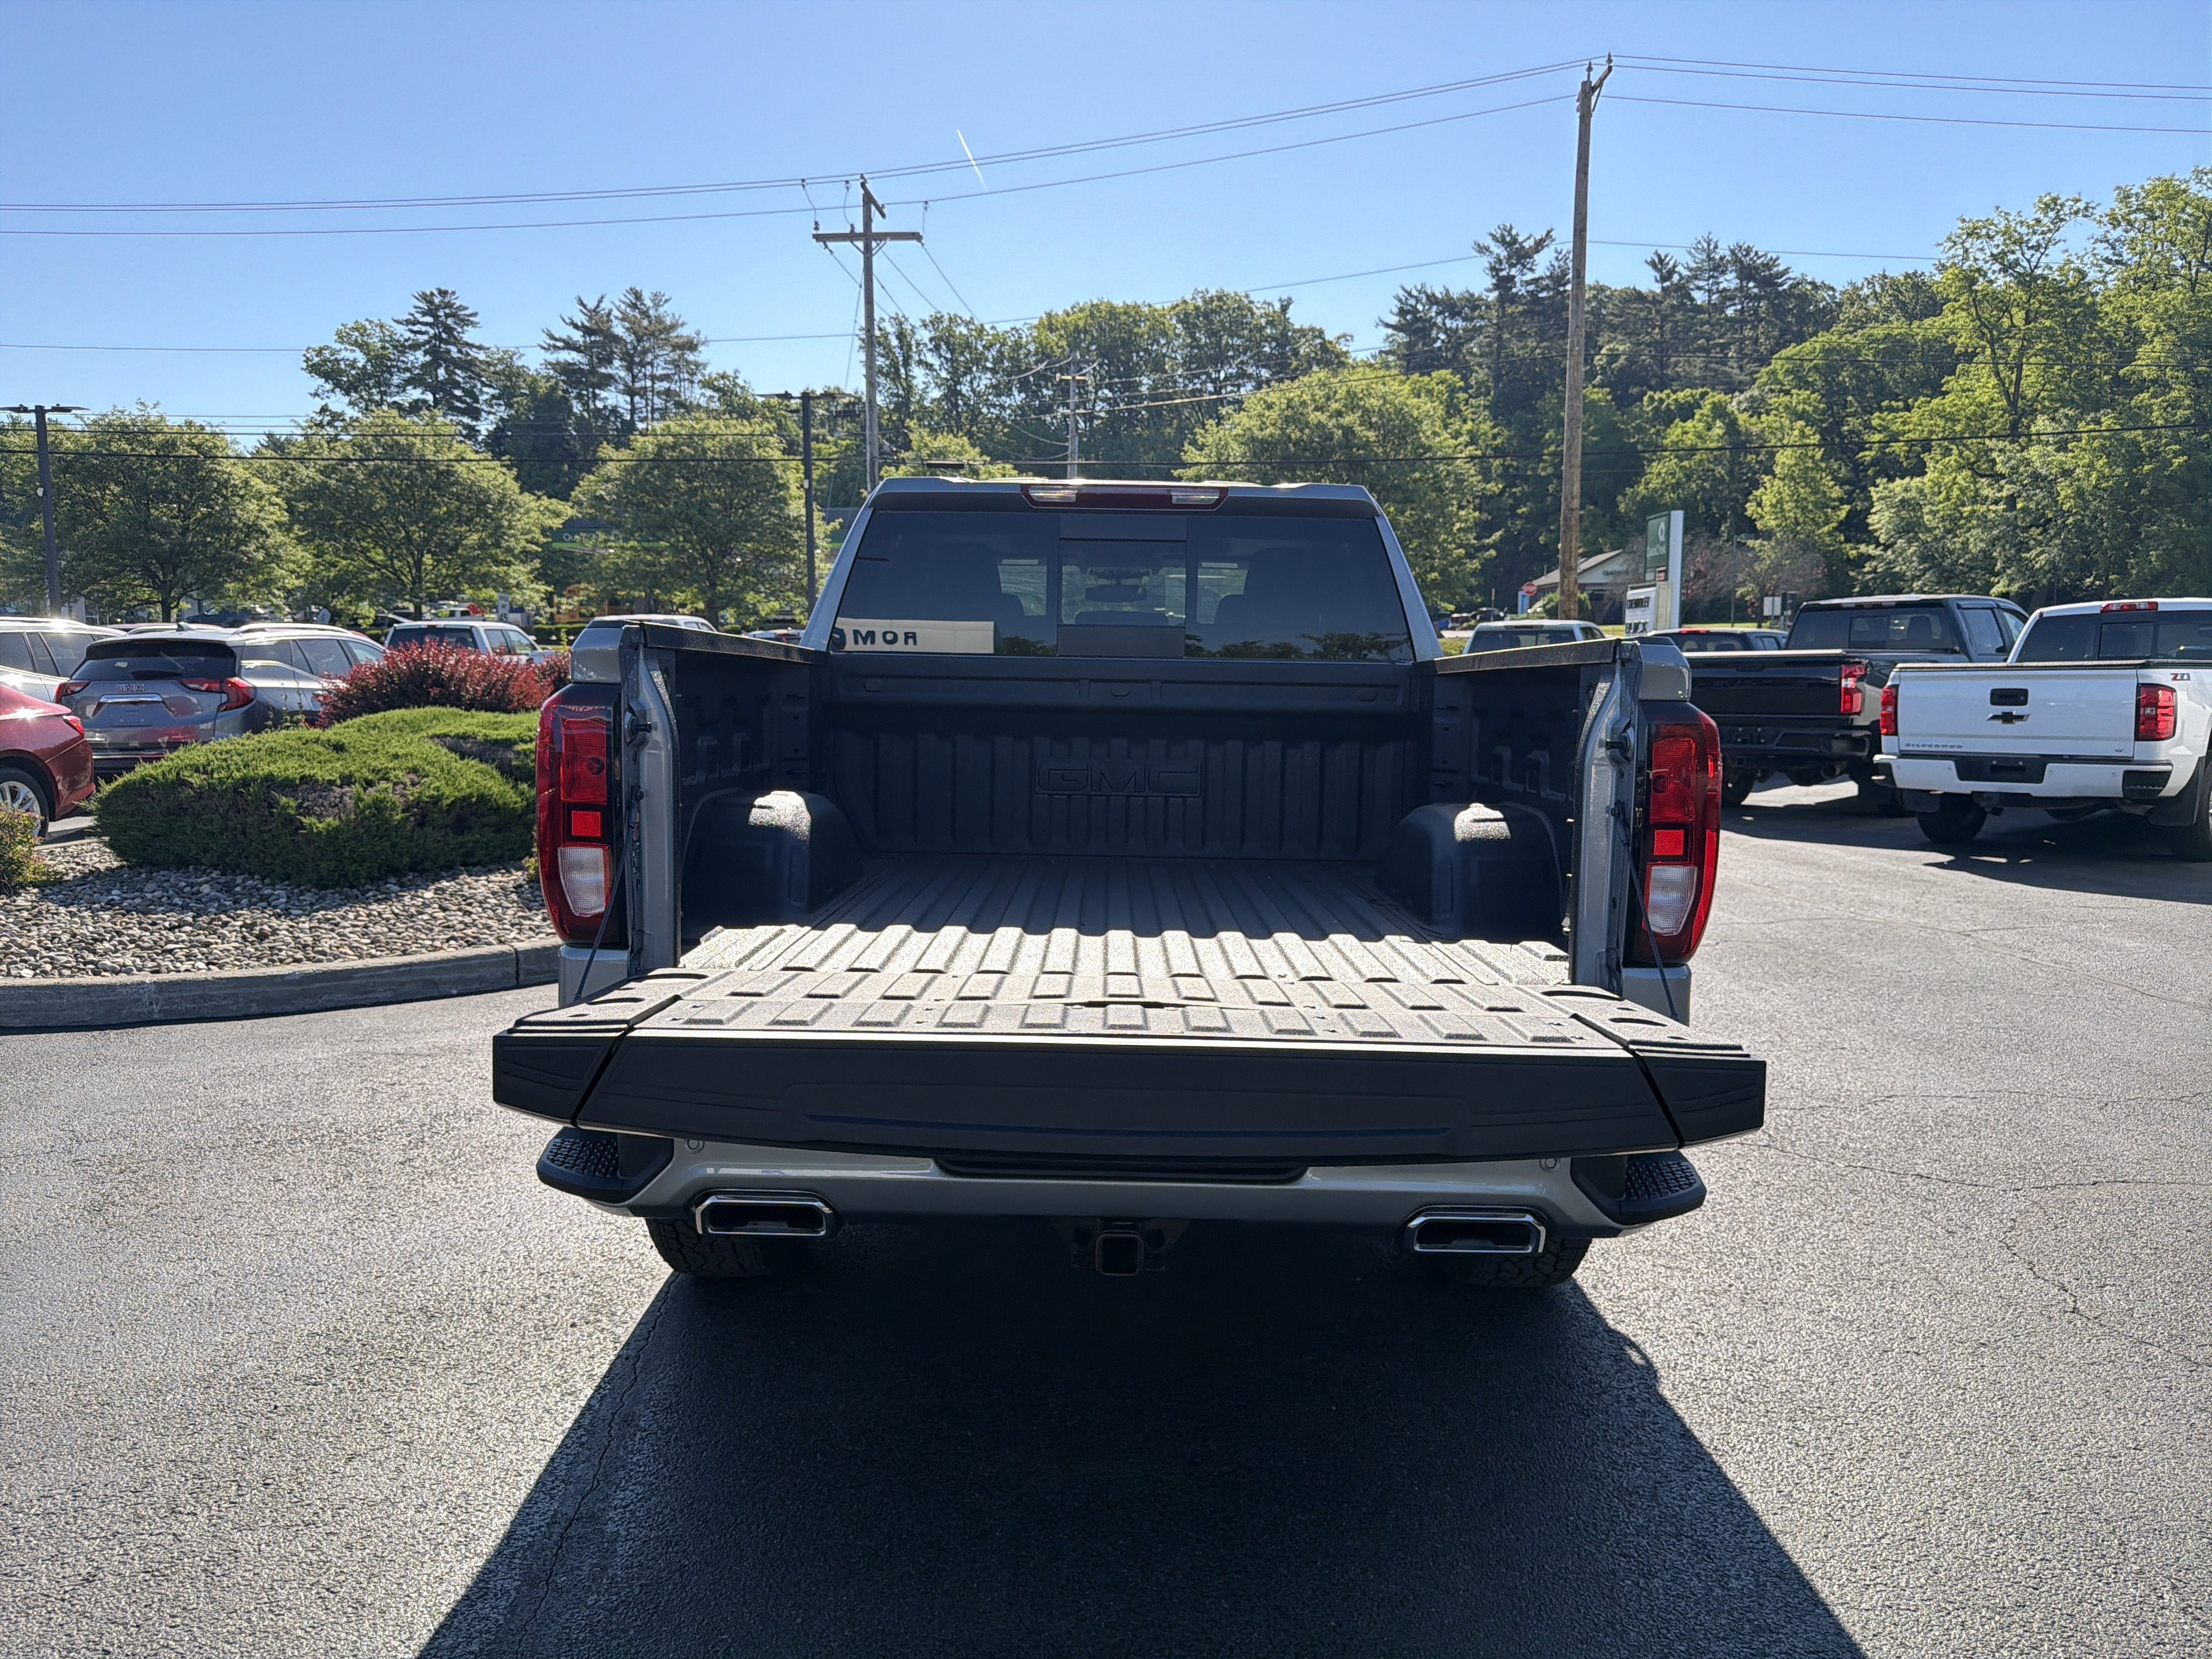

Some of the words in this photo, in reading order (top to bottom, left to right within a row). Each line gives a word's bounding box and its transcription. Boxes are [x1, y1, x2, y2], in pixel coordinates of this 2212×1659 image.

[499, 613, 508, 623] 45
[2170, 673, 2191, 681] Z71
[114, 683, 145, 692] GMC
[1037, 759, 1200, 794] GMC
